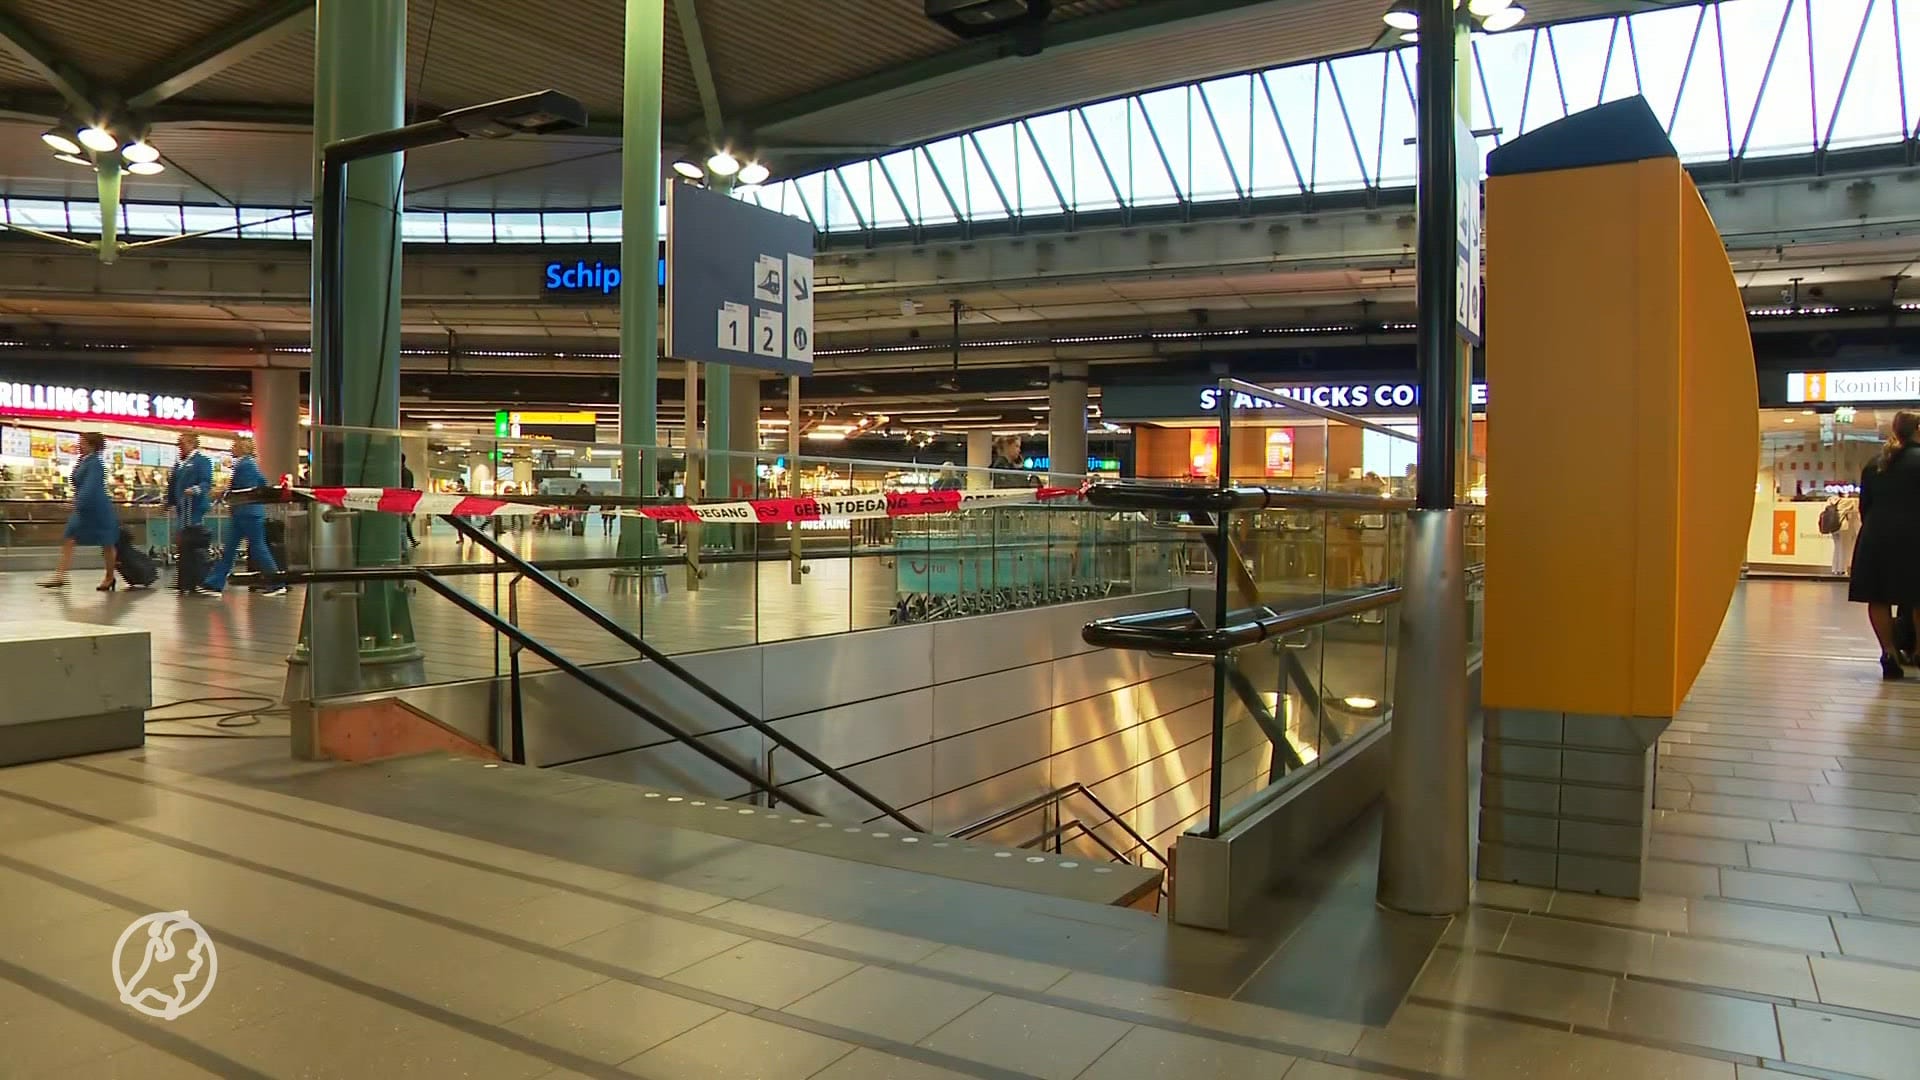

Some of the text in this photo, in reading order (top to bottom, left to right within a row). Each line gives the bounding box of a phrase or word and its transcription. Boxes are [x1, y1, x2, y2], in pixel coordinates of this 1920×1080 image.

[546, 260, 665, 293] Schipl
[729, 320, 774, 352] 1 2
[92, 389, 149, 417] SINCE
[152, 394, 195, 421] 1954
[1374, 384, 1487, 406] COE
[794, 498, 909, 517] GEEN TOEGANG
[931, 564, 946, 573] TUI
